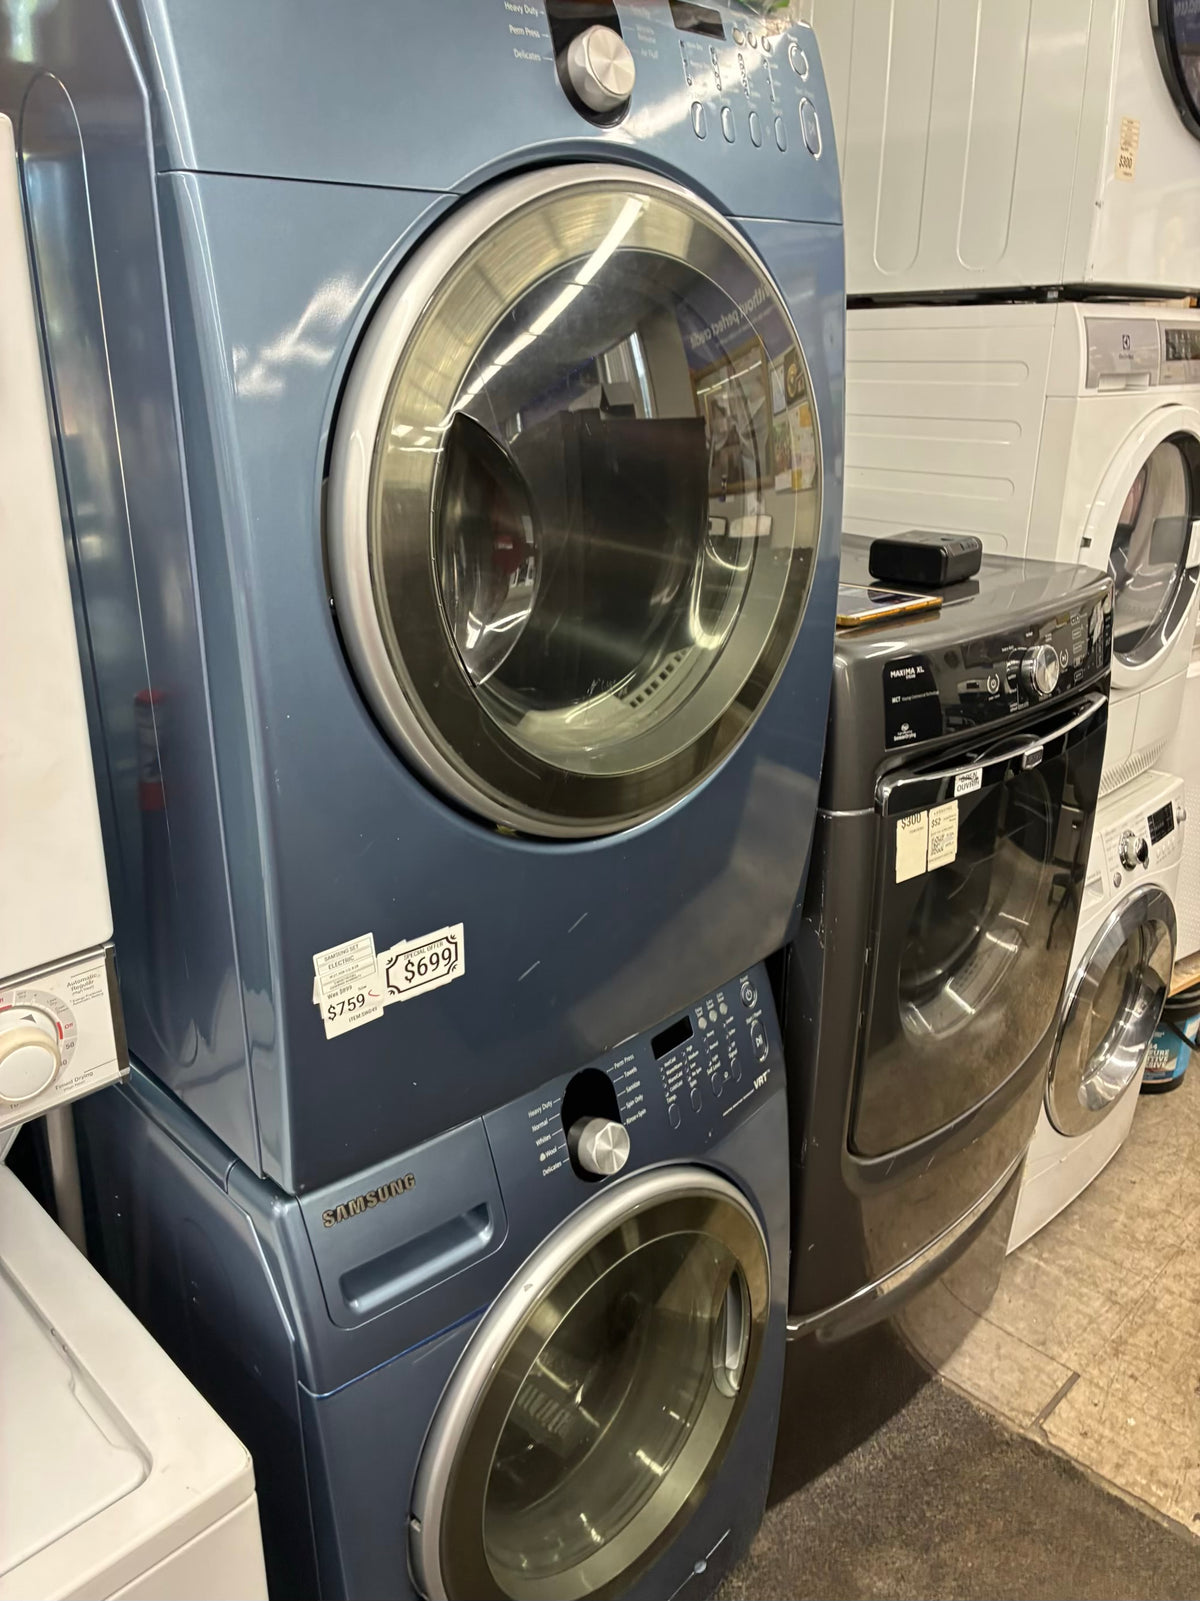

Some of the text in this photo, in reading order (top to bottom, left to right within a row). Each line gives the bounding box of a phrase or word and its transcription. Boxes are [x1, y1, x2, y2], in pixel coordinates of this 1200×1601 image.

[504, 0, 538, 17] Heavy Duty
[513, 48, 541, 61] Delicates
[890, 666, 916, 679] MAXIMA
[916, 666, 925, 674] XL
[324, 948, 349, 962] SAMSUNG
[403, 941, 444, 961] SPECIAL OFFER
[328, 955, 355, 970] ELECTRIC
[404, 947, 452, 984] $699
[327, 993, 366, 1021] $759
[64, 1022, 74, 1030] Off
[66, 1042, 75, 1050] 50
[753, 1071, 767, 1090] VRT
[528, 1100, 553, 1118] Heavy Duty
[532, 1117, 549, 1133] Normal
[536, 1134, 552, 1147] Whites
[545, 1145, 558, 1158] Wool
[542, 1161, 562, 1177] Delicates
[321, 1172, 416, 1228] SAMSUNG
